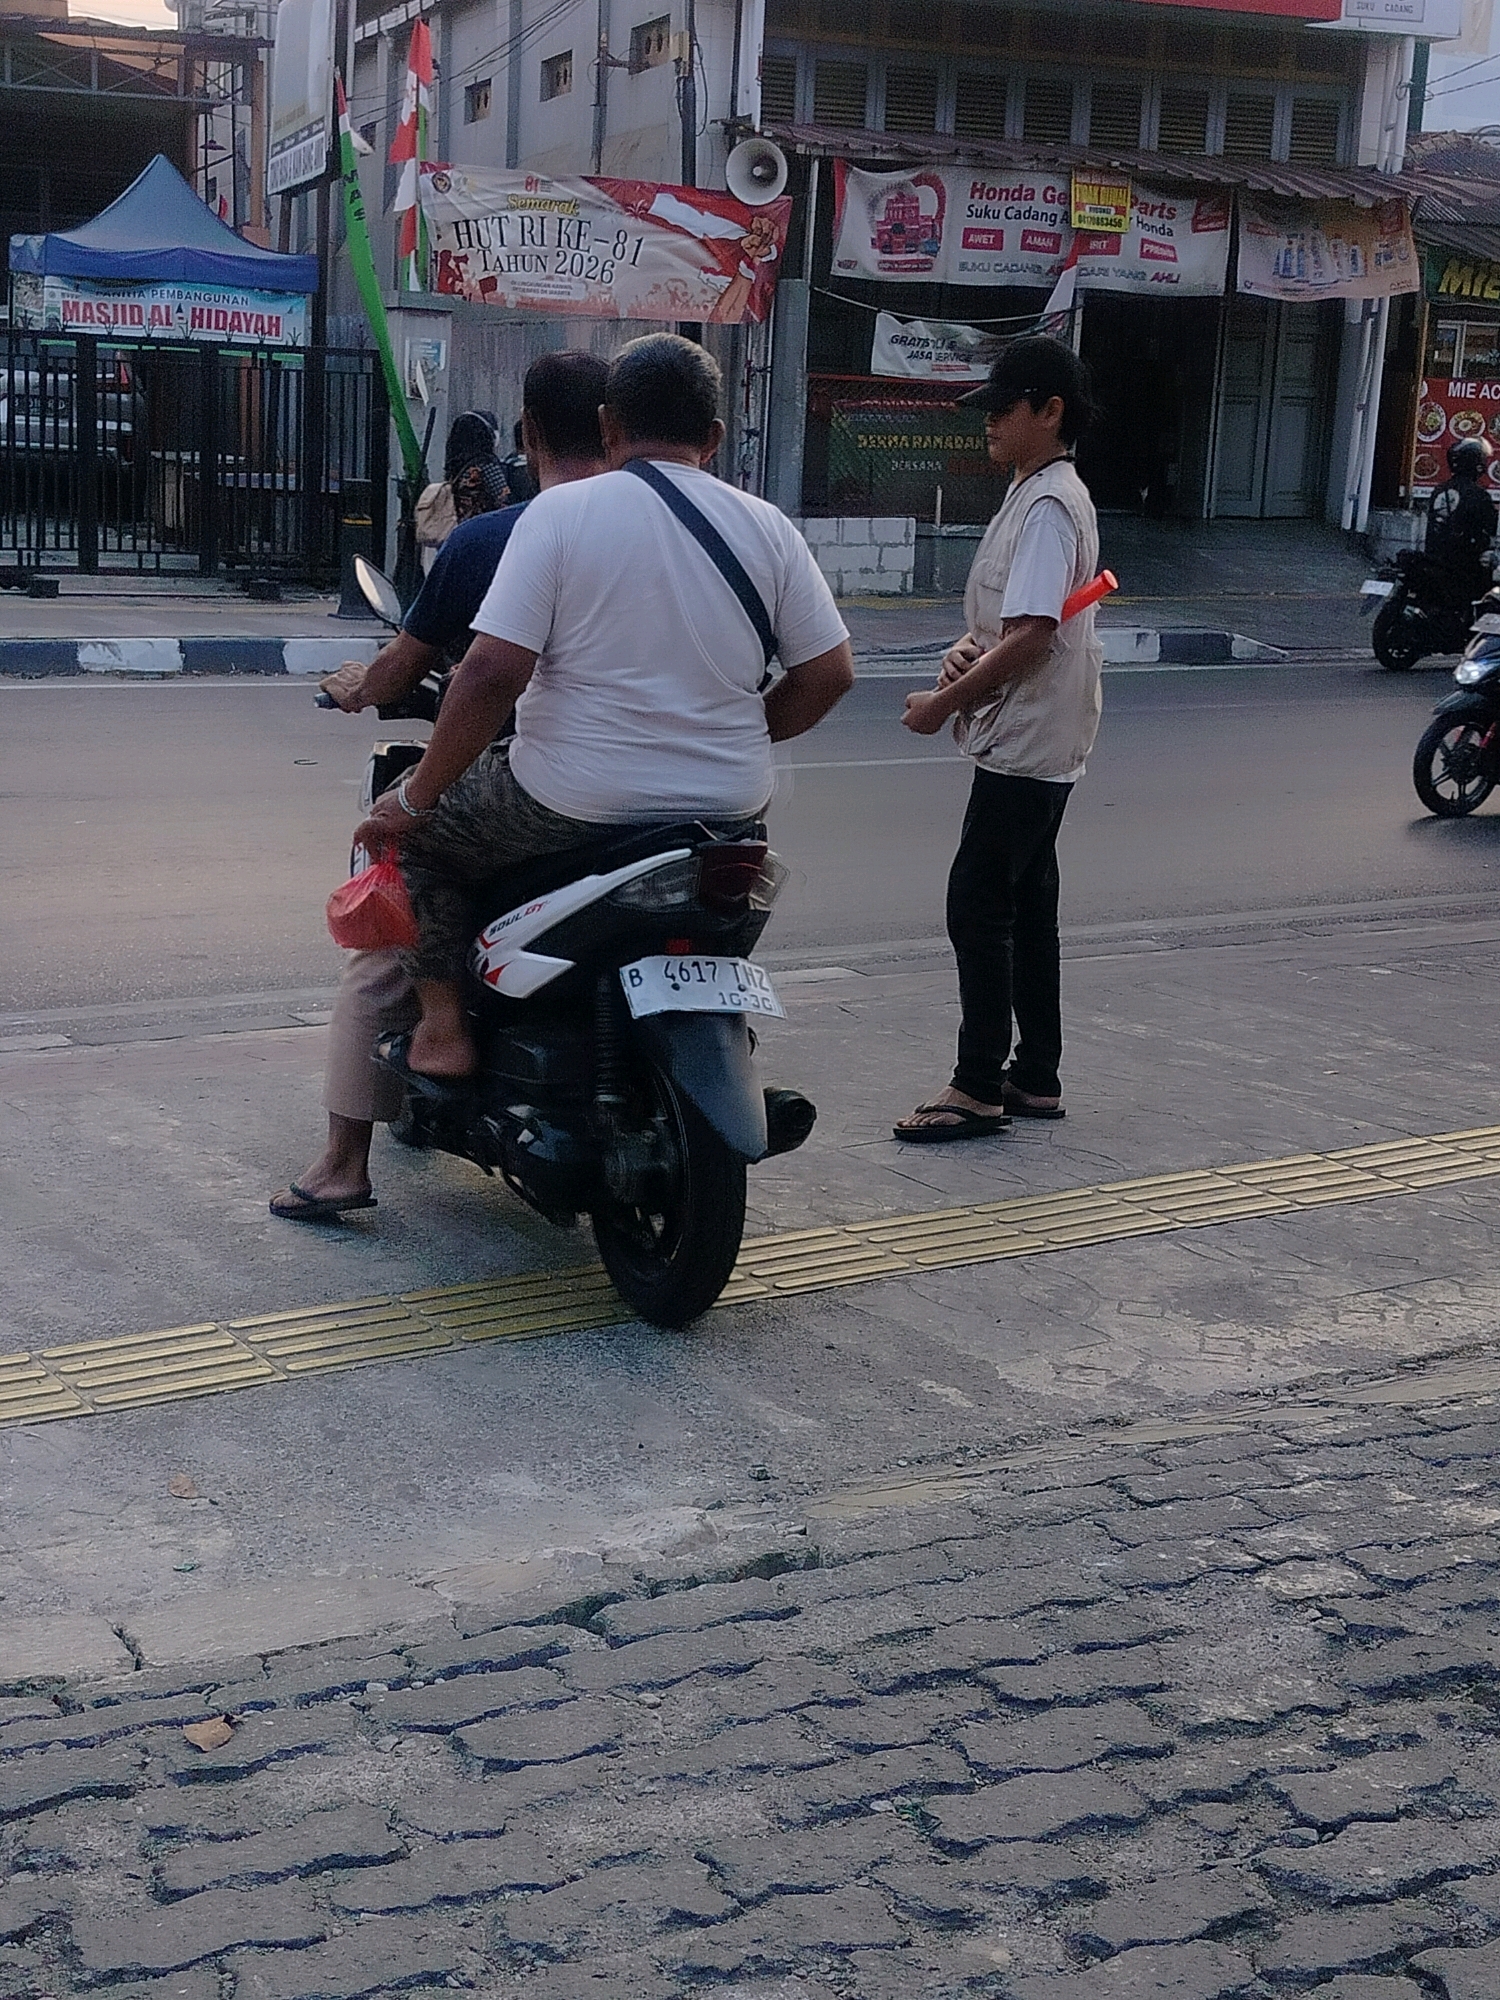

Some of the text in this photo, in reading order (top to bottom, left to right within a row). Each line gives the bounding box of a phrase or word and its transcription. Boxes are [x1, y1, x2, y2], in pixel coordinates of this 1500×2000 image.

[969, 181, 1036, 203] Honda
[508, 193, 580, 217] Semarak
[452, 215, 510, 250] HUT
[519, 215, 547, 247] RI
[966, 204, 1001, 220] Suku
[1004, 206, 1058, 227] Cadang
[1136, 216, 1174, 237] Honda
[968, 233, 996, 245] AWET
[1026, 235, 1053, 247] AMAN
[477, 249, 616, 284] TAHUN 2026
[151, 289, 249, 306] PEMBANGUNAN
[62, 300, 144, 327] MASJID
[149, 302, 174, 328] AL
[190, 306, 283, 338] HIDAYAH
[907, 350, 933, 360] JASA
[1448, 381, 1478, 398] MIE
[489, 913, 522, 937] SOUL
[629, 961, 770, 992] B 4617 THZ
